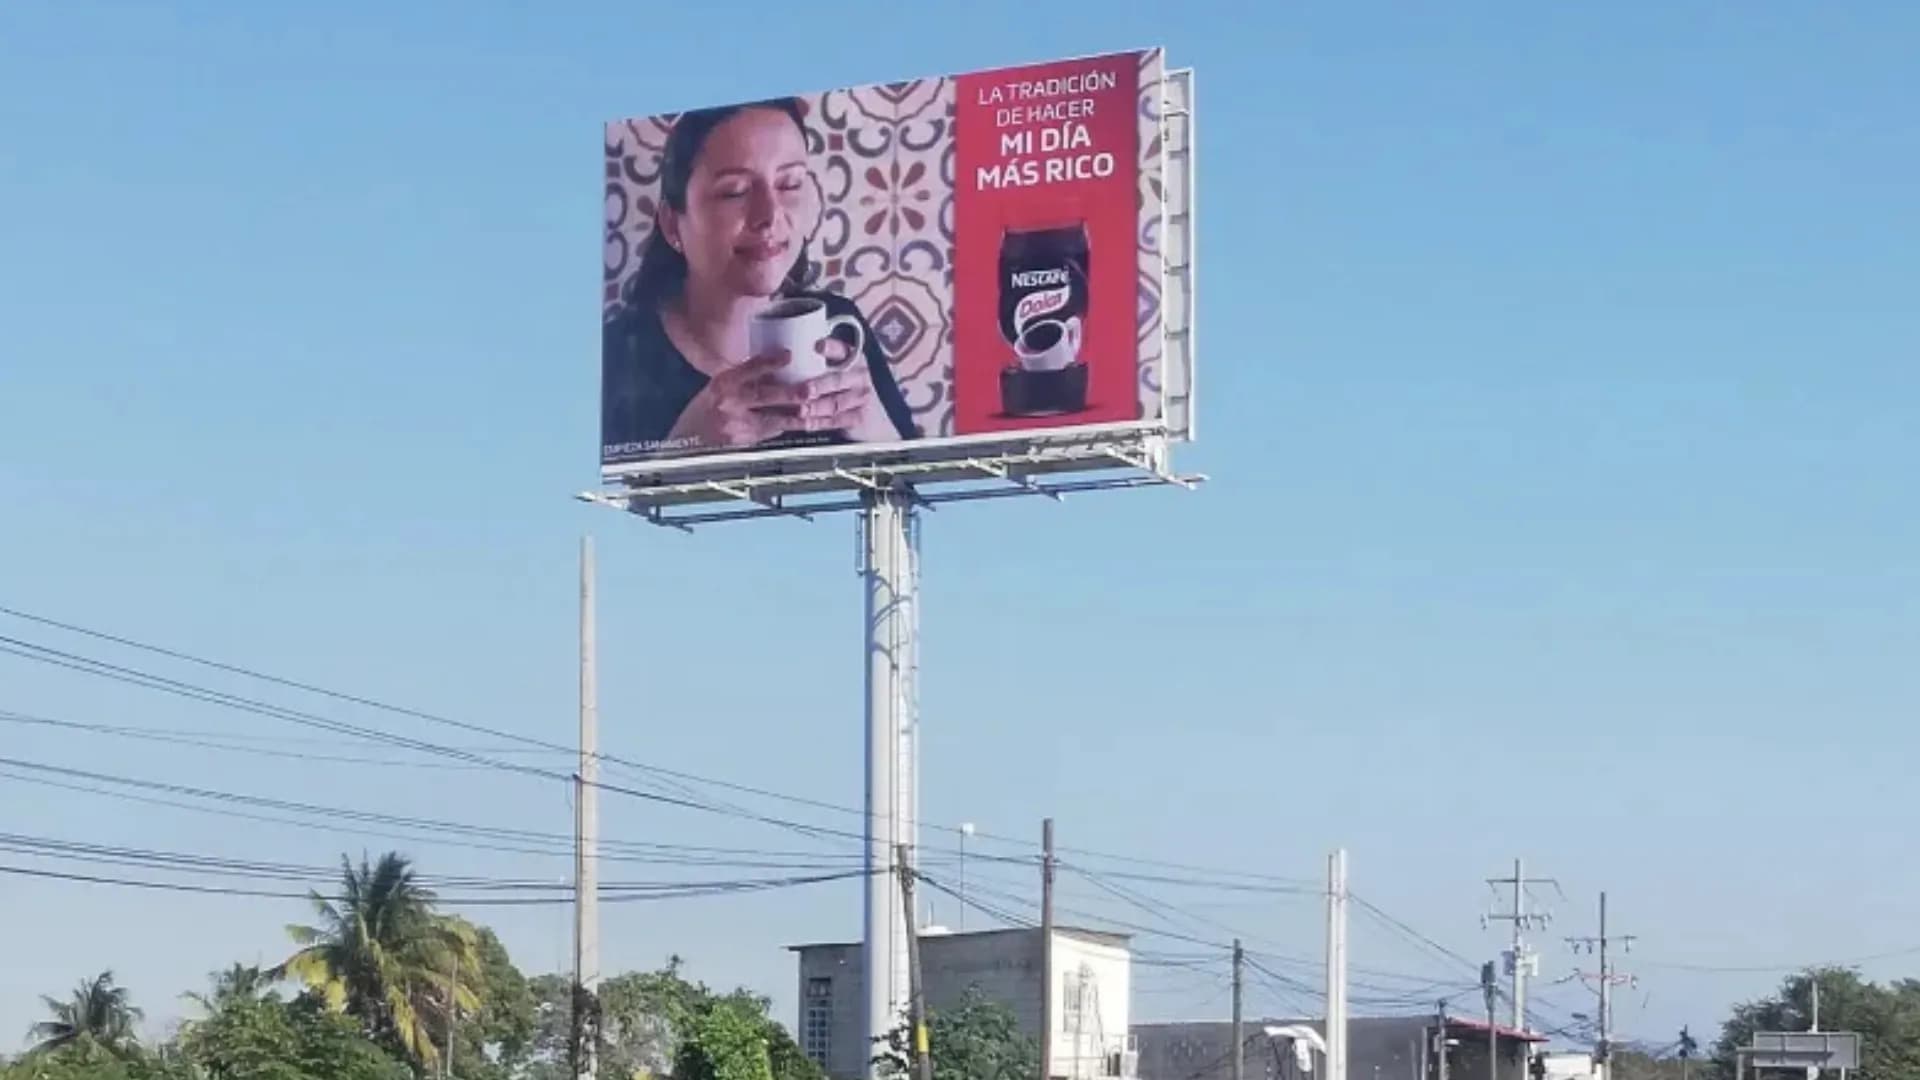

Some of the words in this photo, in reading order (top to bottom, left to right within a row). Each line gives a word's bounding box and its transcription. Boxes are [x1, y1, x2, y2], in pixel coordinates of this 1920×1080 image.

[978, 86, 1003, 105] LA
[1006, 70, 1116, 100] TRADICIÓN
[996, 107, 1023, 127] DE
[1027, 99, 1094, 123] HACER
[1001, 131, 1033, 157] MI
[1041, 121, 1092, 152] DÍA
[976, 158, 1039, 191] MÁS
[1045, 152, 1114, 183] RICO
